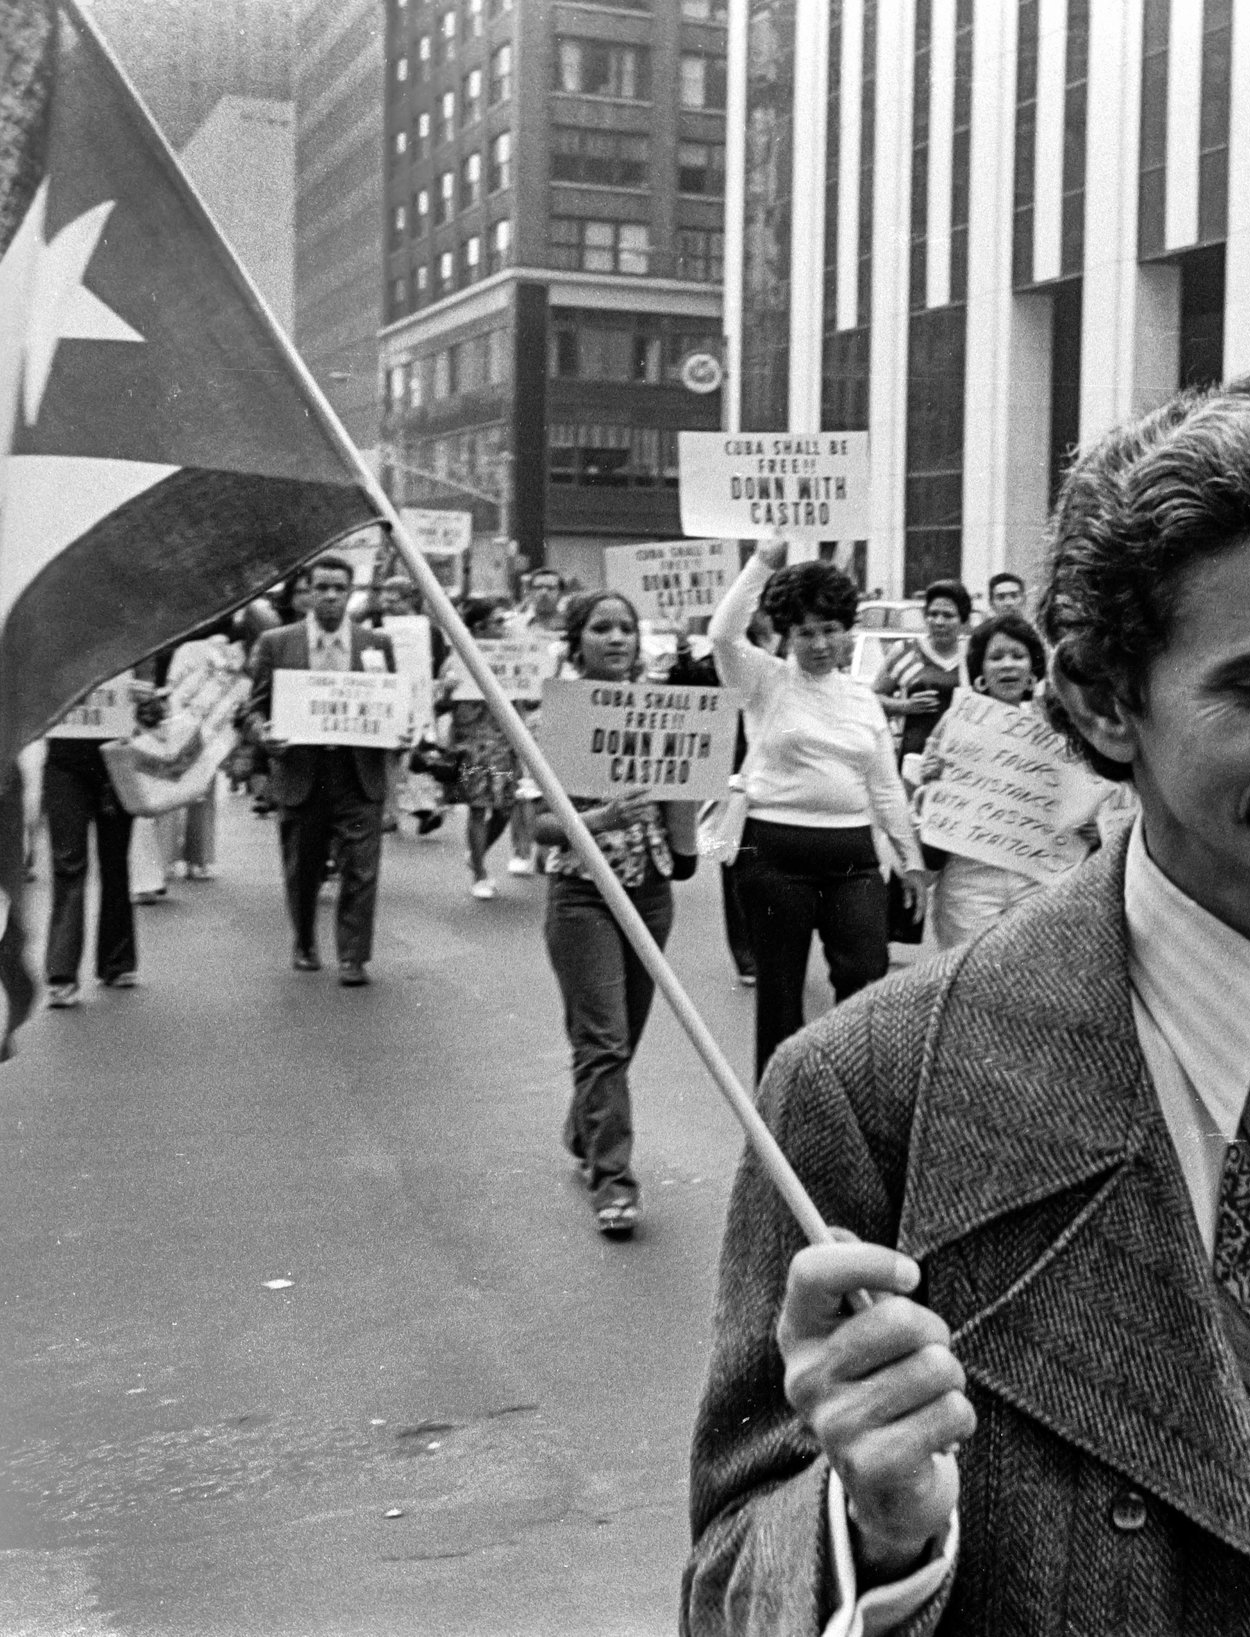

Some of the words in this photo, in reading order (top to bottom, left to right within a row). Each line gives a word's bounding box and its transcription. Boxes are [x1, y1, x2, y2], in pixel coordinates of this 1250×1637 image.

[725, 440, 764, 455] CUBA
[773, 440, 820, 455] SHALL
[829, 440, 848, 455] BE
[758, 458, 816, 474] FREE!!
[731, 476, 784, 500] DOWN
[798, 476, 846, 500] WITH
[751, 502, 830, 525] CASTRO
[635, 549, 664, 561] CUBA
[642, 573, 681, 592] DOWN
[689, 569, 724, 588] WITH
[657, 589, 712, 607] CASTRO
[591, 688, 634, 708] CUBA
[645, 692, 690, 710] SHALL
[699, 694, 718, 711] BE
[591, 728, 653, 756] DOWN
[663, 732, 712, 759] WITH
[610, 757, 690, 784] CASTRO
